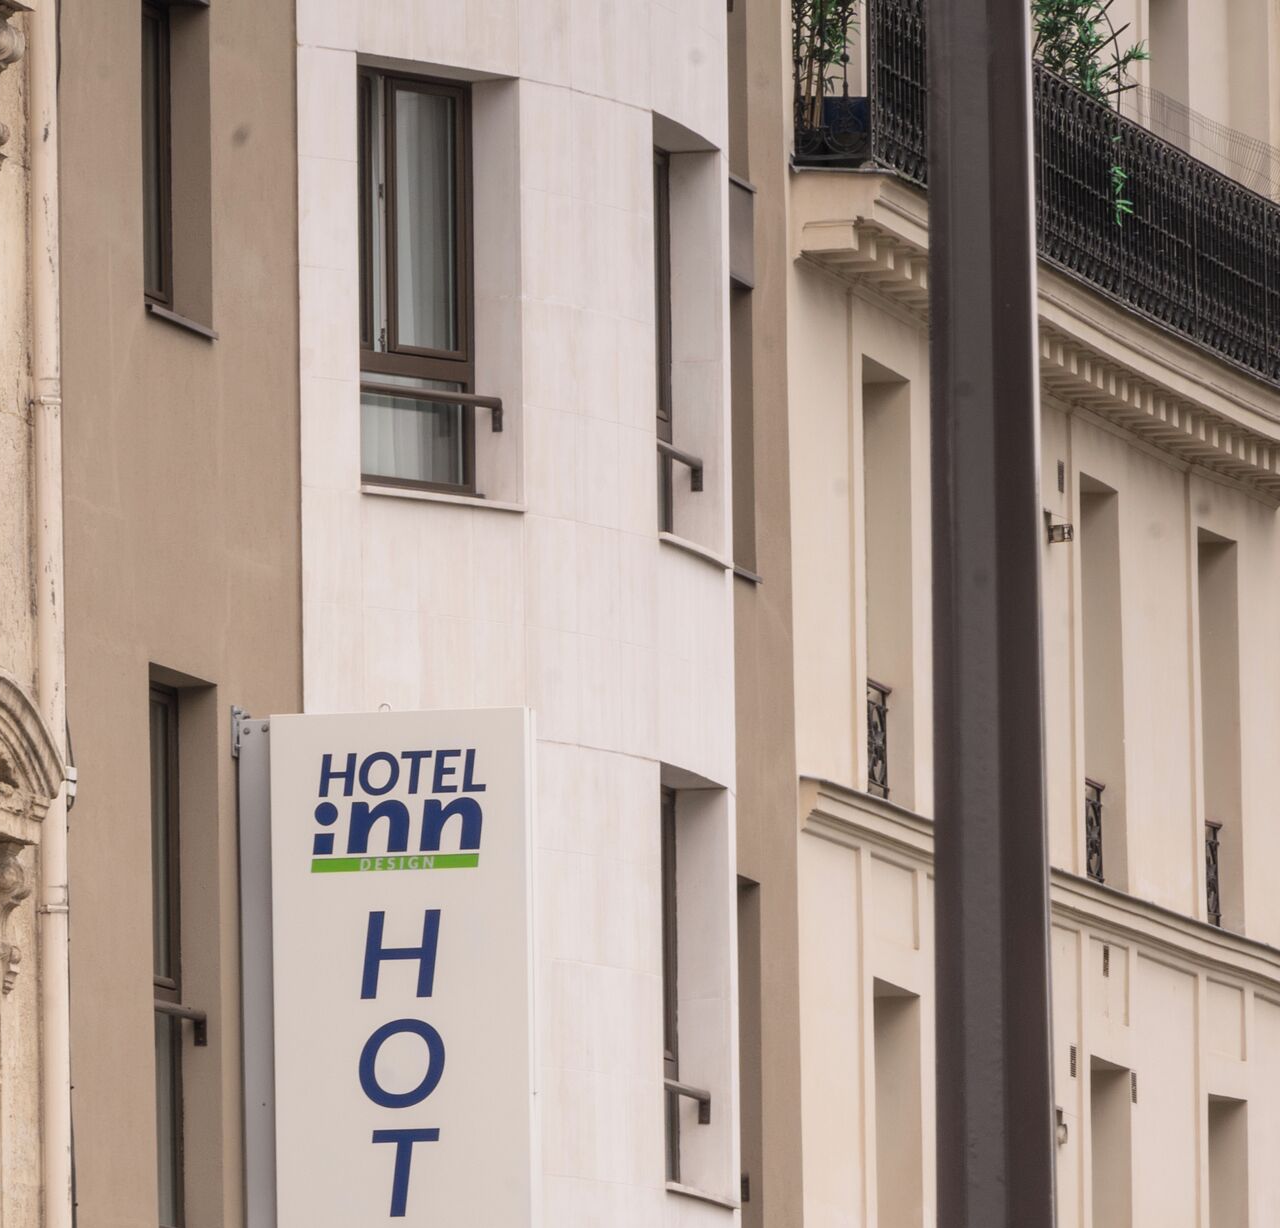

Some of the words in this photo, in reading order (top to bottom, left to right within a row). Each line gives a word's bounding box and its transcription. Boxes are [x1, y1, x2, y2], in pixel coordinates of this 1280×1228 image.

[318, 748, 487, 798] HOTEL
[312, 796, 483, 856] inn
[359, 855, 435, 872] DESIGN
